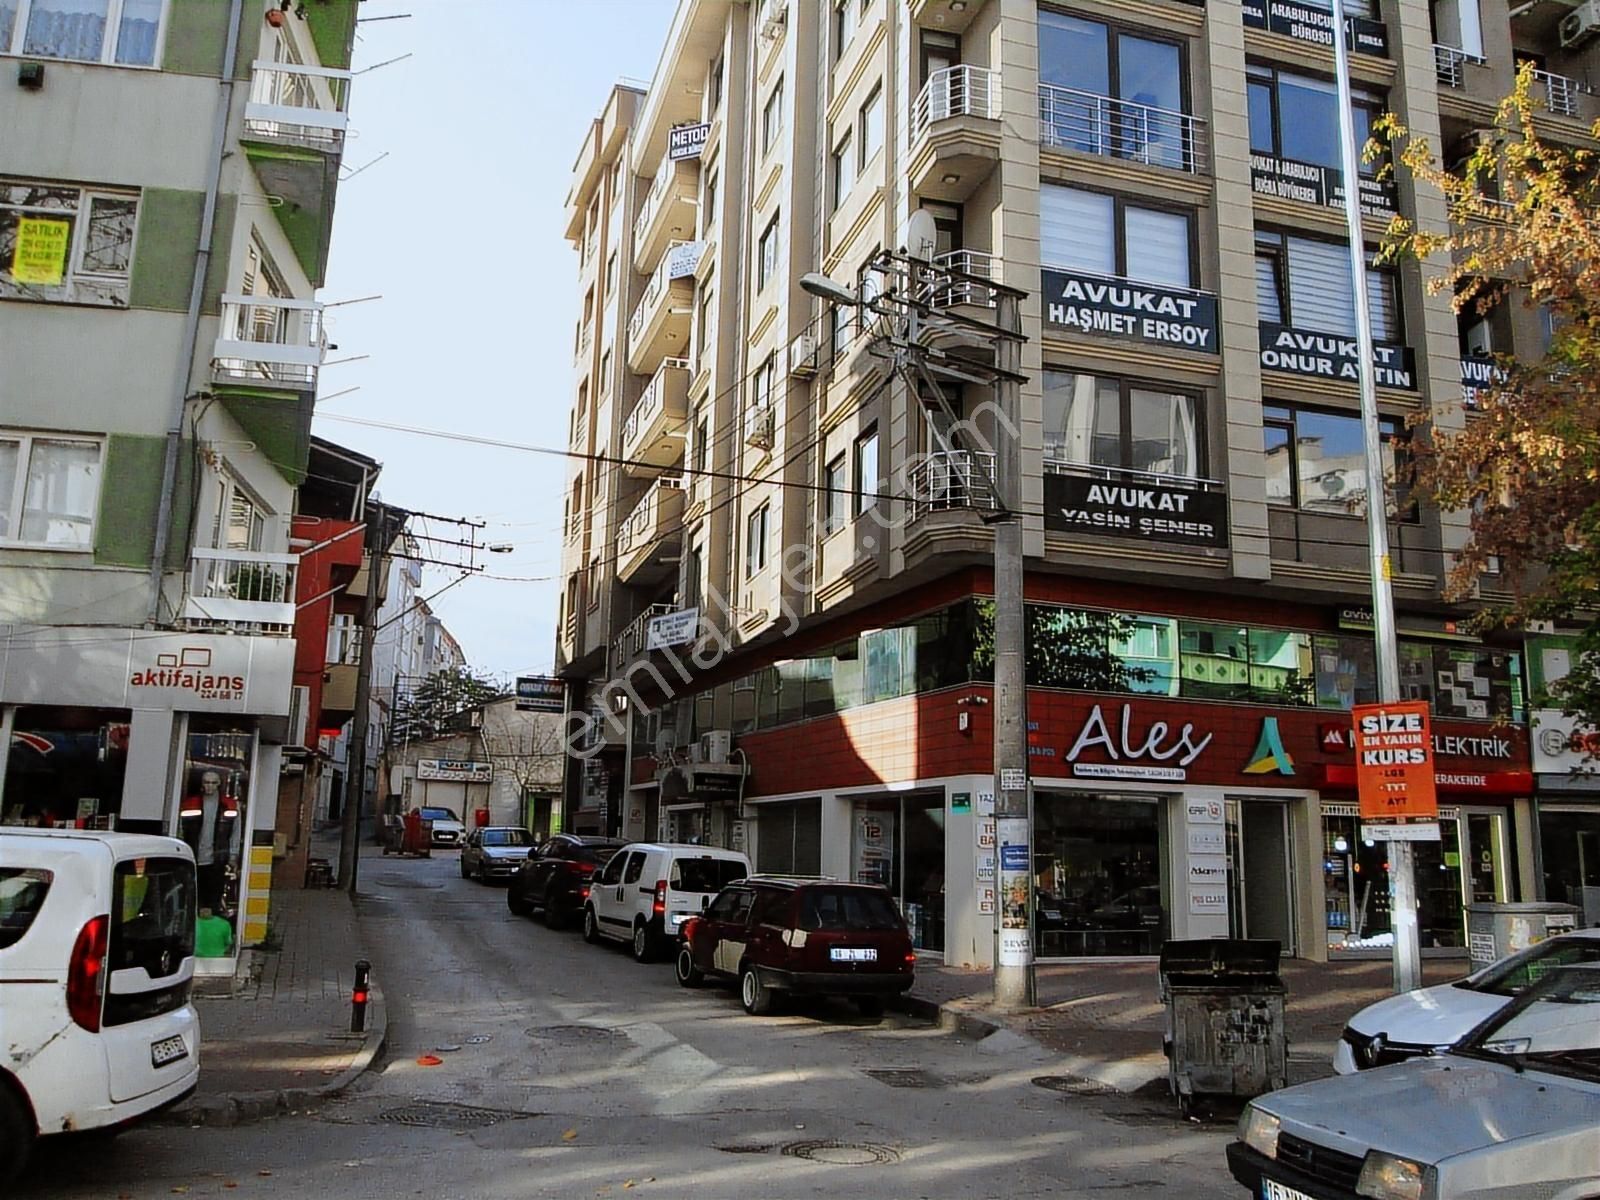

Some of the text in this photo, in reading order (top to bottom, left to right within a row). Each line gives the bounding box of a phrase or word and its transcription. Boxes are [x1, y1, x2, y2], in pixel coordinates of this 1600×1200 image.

[1291, 23, 1333, 45] BÜROSU
[1062, 279, 1198, 319] AVUKAT
[1049, 303, 1210, 347] HAŞMET ERSOY
[1275, 331, 1394, 364] AVUKT
[1261, 350, 1410, 387] ONUR ATIN
[1086, 484, 1189, 513] AVUKAT
[130, 668, 244, 692] aktifajans
[1066, 703, 1213, 767] Ales
[1361, 710, 1421, 735] SİZE
[1363, 735, 1381, 747] EN
[1383, 733, 1423, 746] YAKIN
[1363, 747, 1426, 767] KURS
[1435, 773, 1487, 786] ERAKENDE
